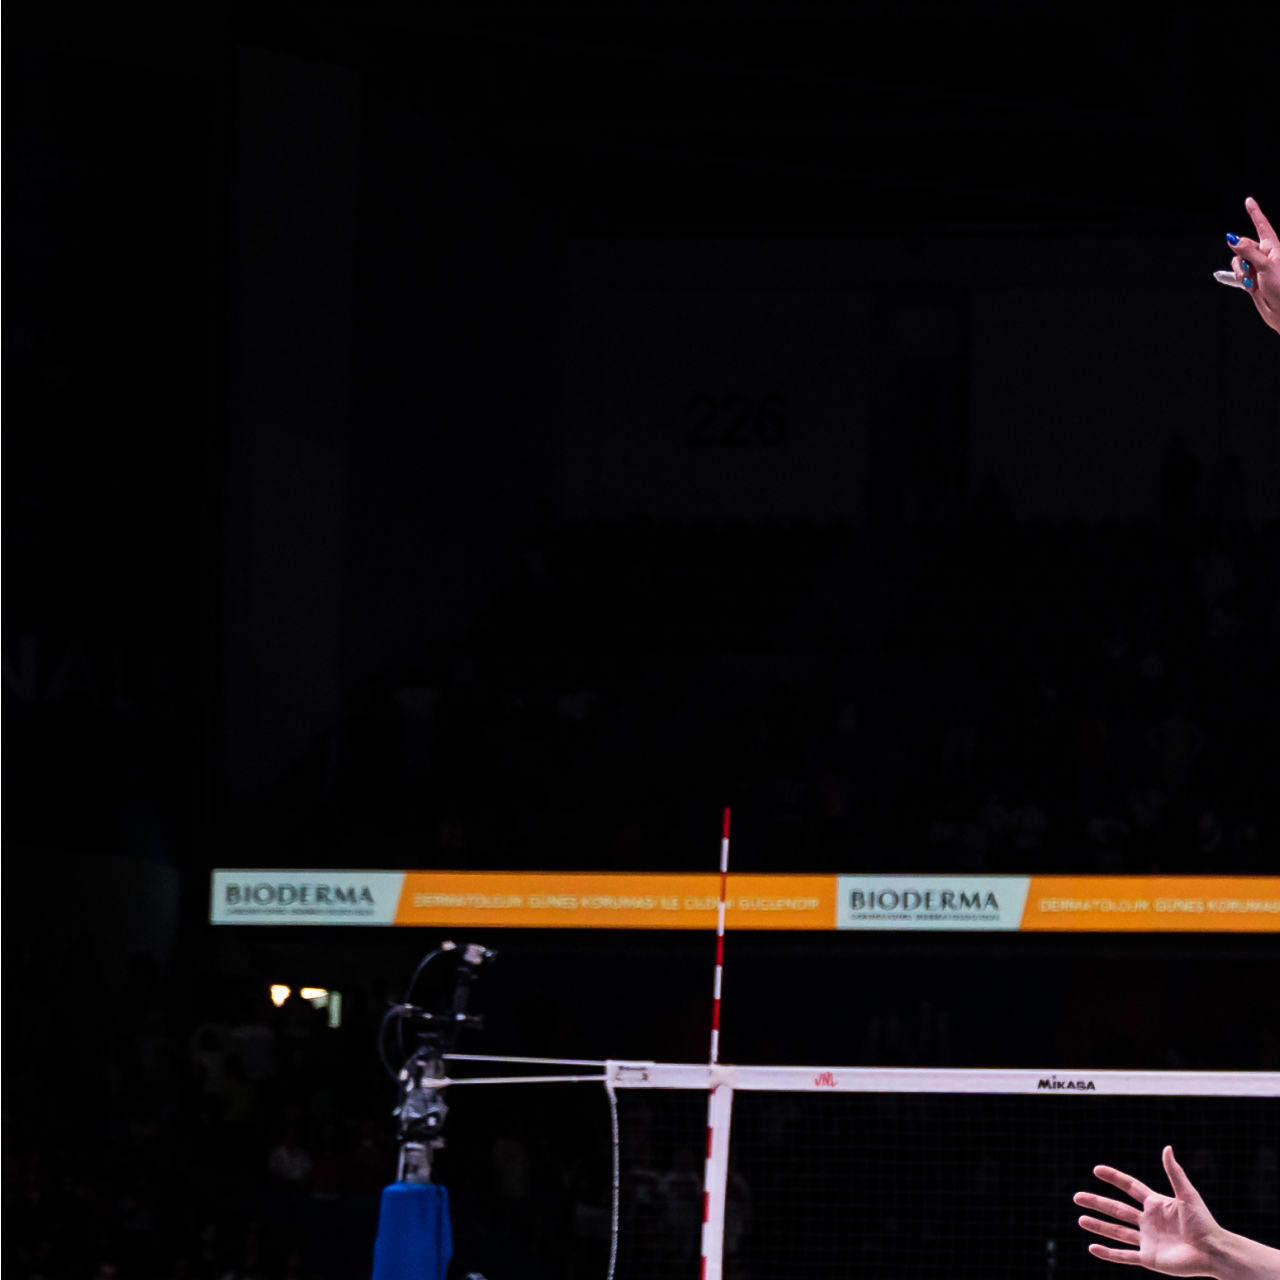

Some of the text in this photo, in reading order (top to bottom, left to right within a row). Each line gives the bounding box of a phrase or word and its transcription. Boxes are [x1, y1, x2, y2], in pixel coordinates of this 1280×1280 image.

[225, 882, 375, 906] BIODERMA
[850, 889, 999, 911] BIODERMA
[1038, 1076, 1096, 1092] MIKASA
